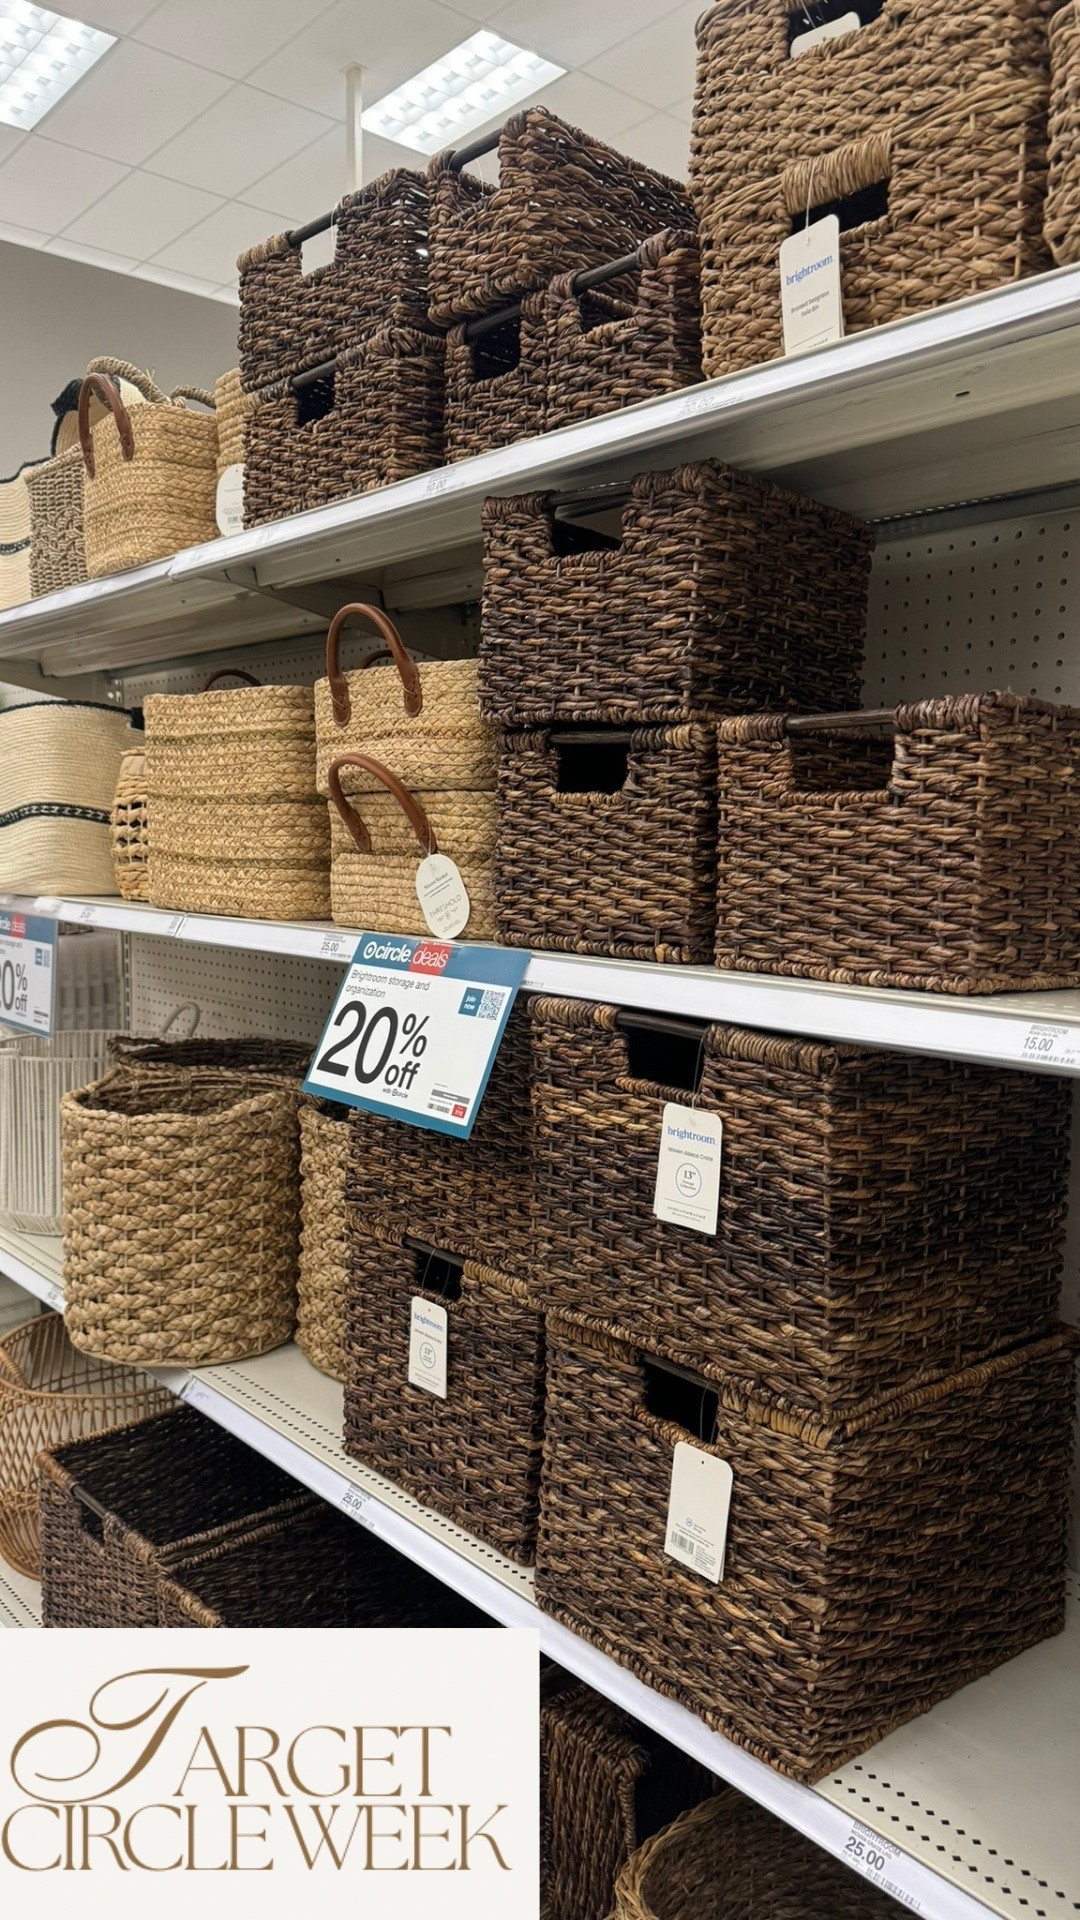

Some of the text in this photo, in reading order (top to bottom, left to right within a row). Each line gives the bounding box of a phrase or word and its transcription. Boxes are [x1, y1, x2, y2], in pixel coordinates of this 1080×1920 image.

[786, 255, 833, 285] brightroom
[321, 941, 339, 952] 25.00
[413, 946, 449, 968] deals
[350, 968, 431, 991] Brightroom storage and
[345, 984, 387, 998] organization
[15, 993, 28, 1012] off
[1024, 1036, 1053, 1051] 15.00
[384, 1061, 420, 1090] off
[667, 1126, 716, 1145] brightroom
[342, 1492, 363, 1510] 25.00
[851, 1830, 867, 1842] WOVEN
[853, 1821, 901, 1857] BRIGHTROOM
[845, 1836, 885, 1871] 25.00
